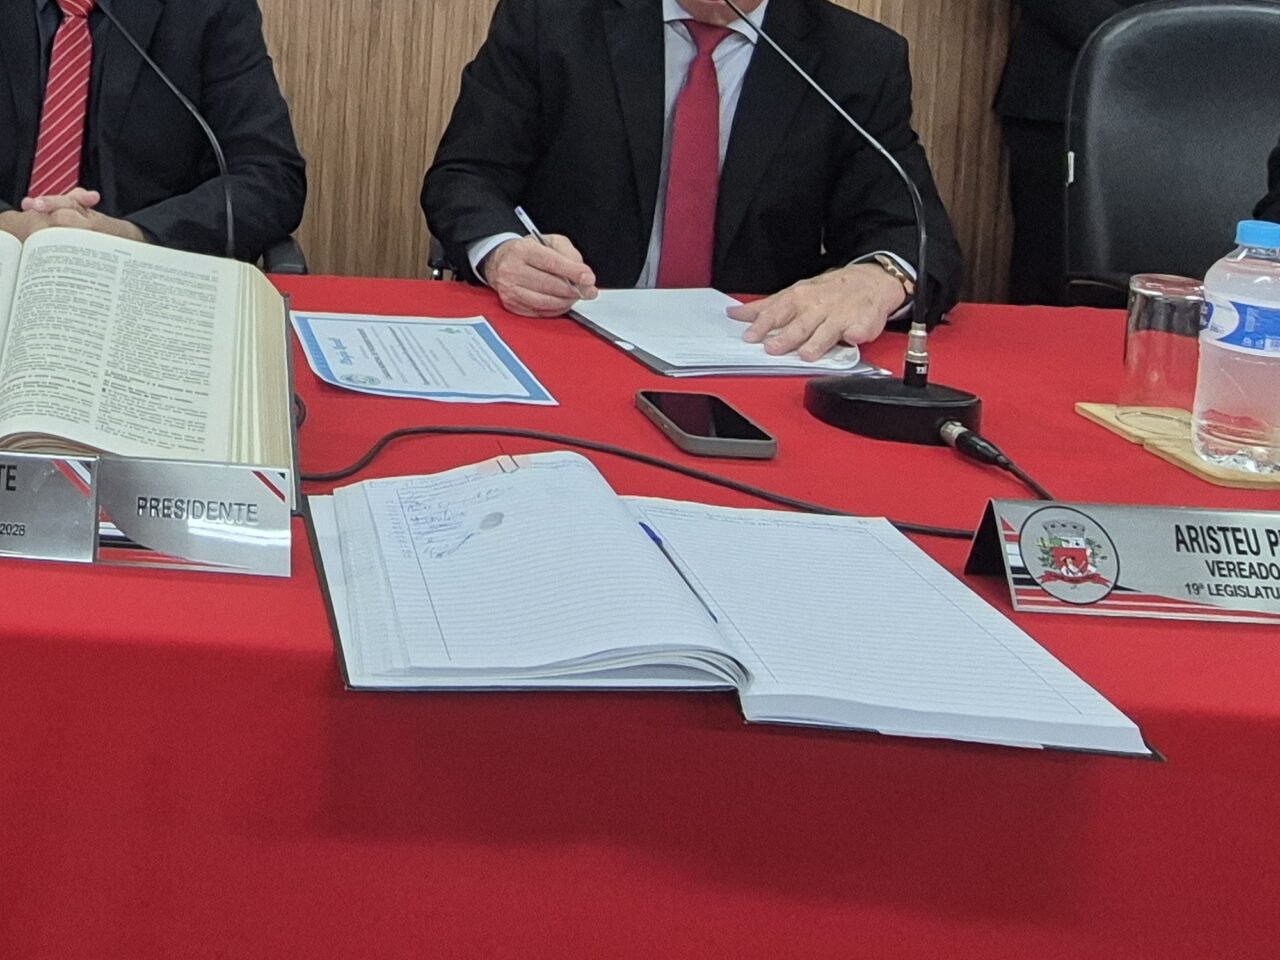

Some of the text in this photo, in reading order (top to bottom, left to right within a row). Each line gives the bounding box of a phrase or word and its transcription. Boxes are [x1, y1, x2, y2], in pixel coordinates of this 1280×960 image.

[137, 496, 259, 523] PRESIDENTE
[1174, 524, 1280, 557] ARISTEU P
[1204, 559, 1280, 581] VEREADO
[1206, 583, 1280, 600] LEGISLATU
